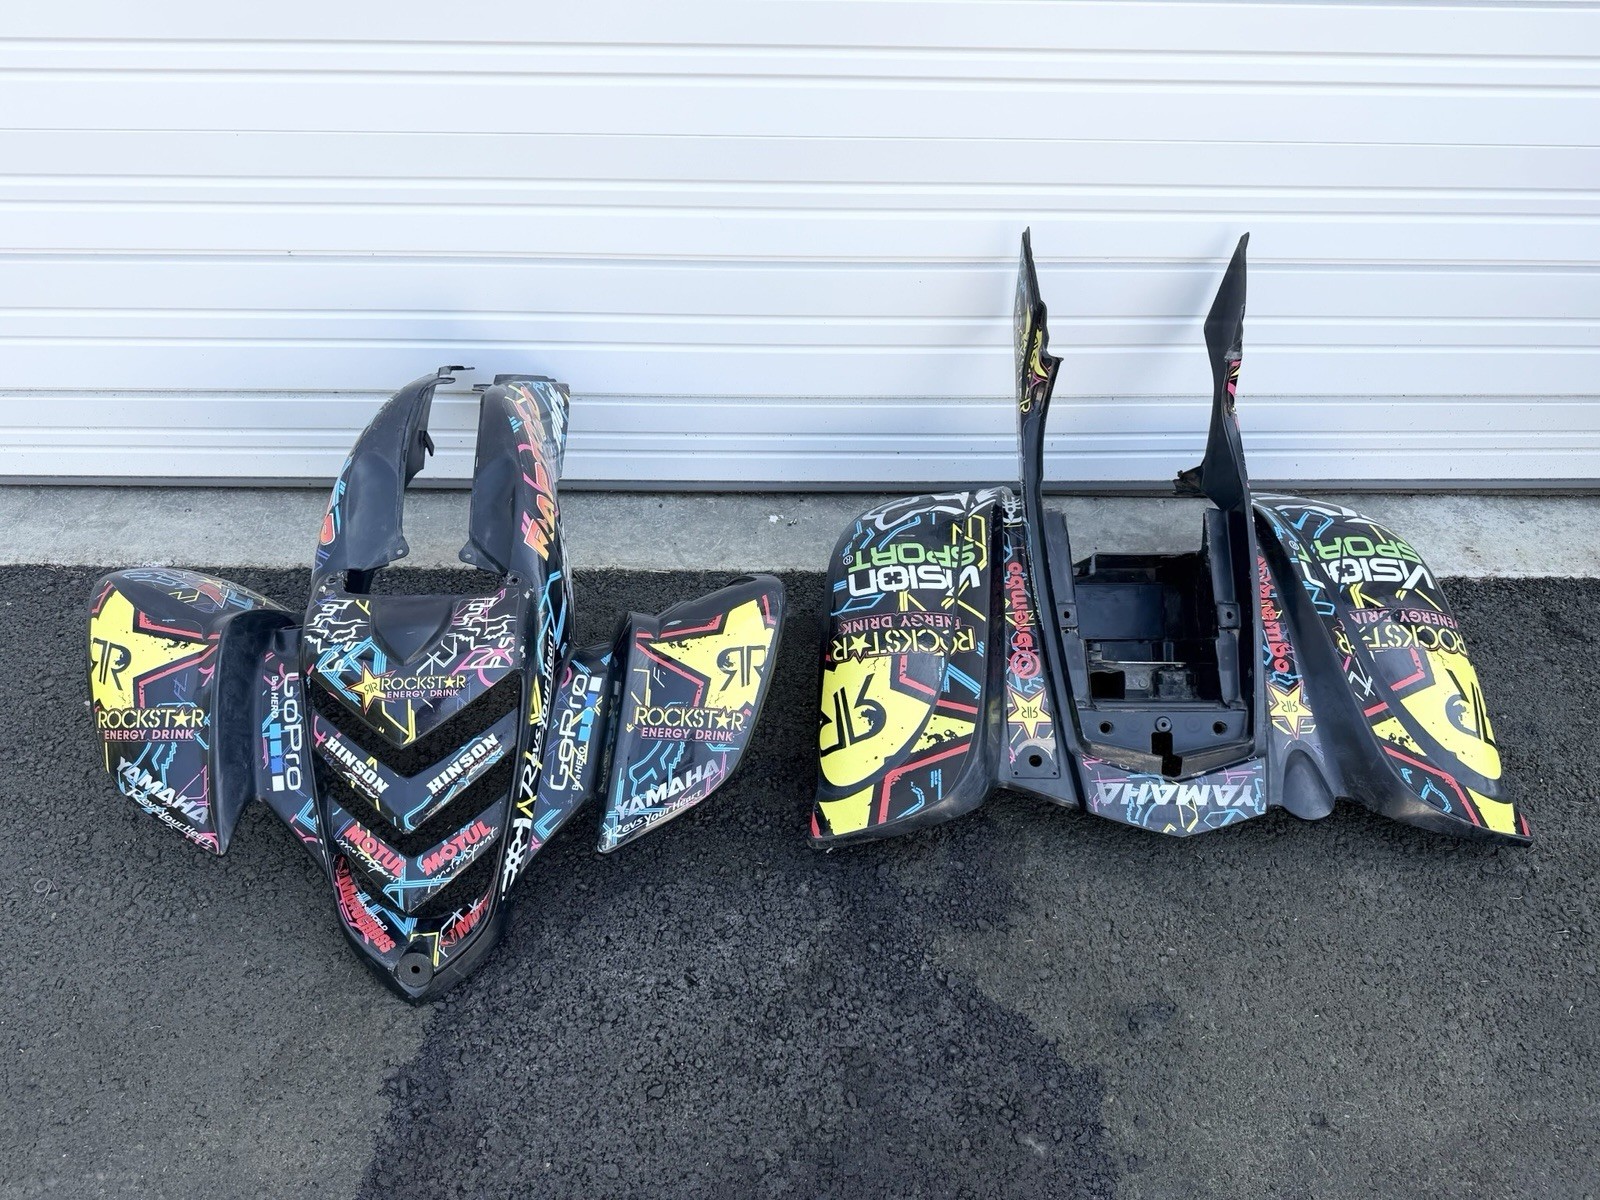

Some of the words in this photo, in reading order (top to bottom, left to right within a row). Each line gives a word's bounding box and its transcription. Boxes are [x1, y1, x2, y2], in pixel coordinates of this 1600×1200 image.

[841, 614, 892, 632] DRINK
[1006, 562, 1033, 651] brembo
[1399, 609, 1454, 627] ENERGY
[386, 690, 426, 699] ENERGY
[429, 688, 459, 698] DRINK
[104, 730, 147, 741] ENERGY
[151, 729, 195, 741] DRINK
[641, 727, 691, 740] ENERGY
[695, 729, 734, 742] DRINK
[116, 756, 209, 825] YAMAHA
[325, 736, 390, 794] HINSON
[426, 733, 499, 795] HINSON
[615, 759, 720, 821] YAMAHA
[1096, 782, 1256, 807] YAMAHA
[344, 824, 407, 878] MOTUL
[422, 821, 492, 876] MOTUL
